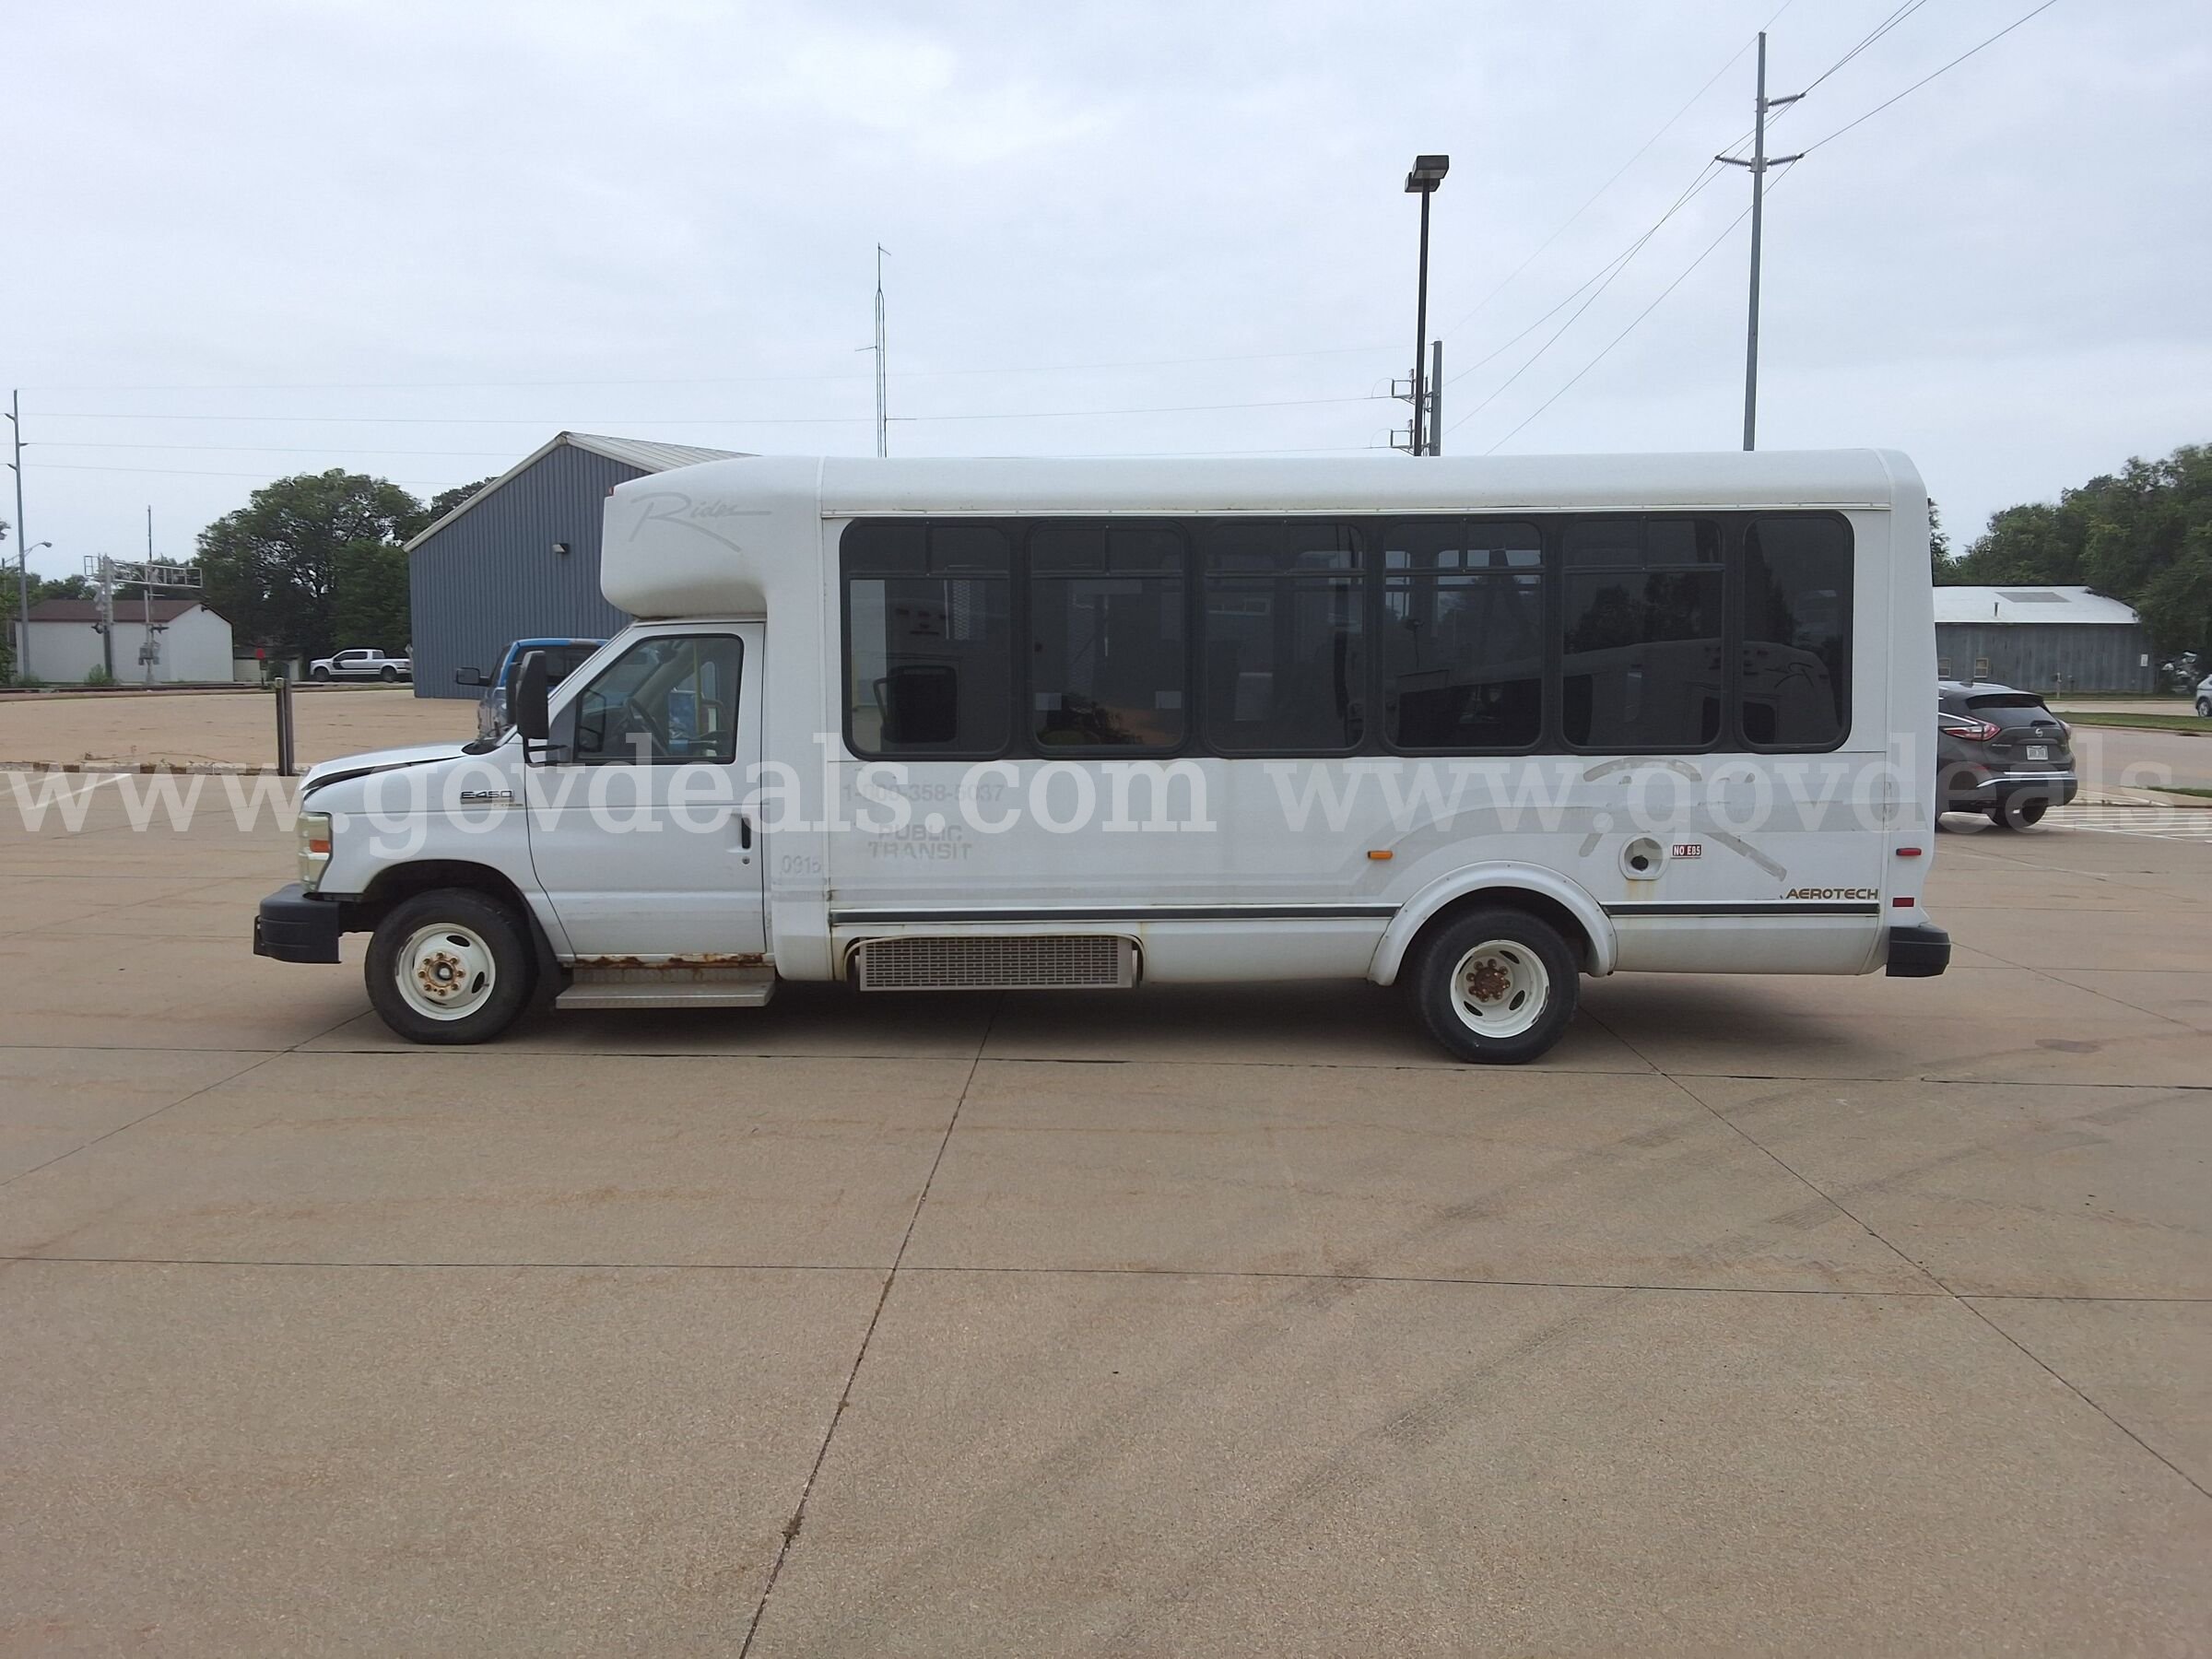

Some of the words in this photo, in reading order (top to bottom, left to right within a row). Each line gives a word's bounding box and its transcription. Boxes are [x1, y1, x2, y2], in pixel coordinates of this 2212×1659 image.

[877, 824, 963, 841] PUBLIC
[867, 841, 973, 861] TRANSIT
[1673, 845, 1685, 856] NO
[1687, 845, 1700, 856] E85
[1784, 887, 1879, 900] AEROTECH
